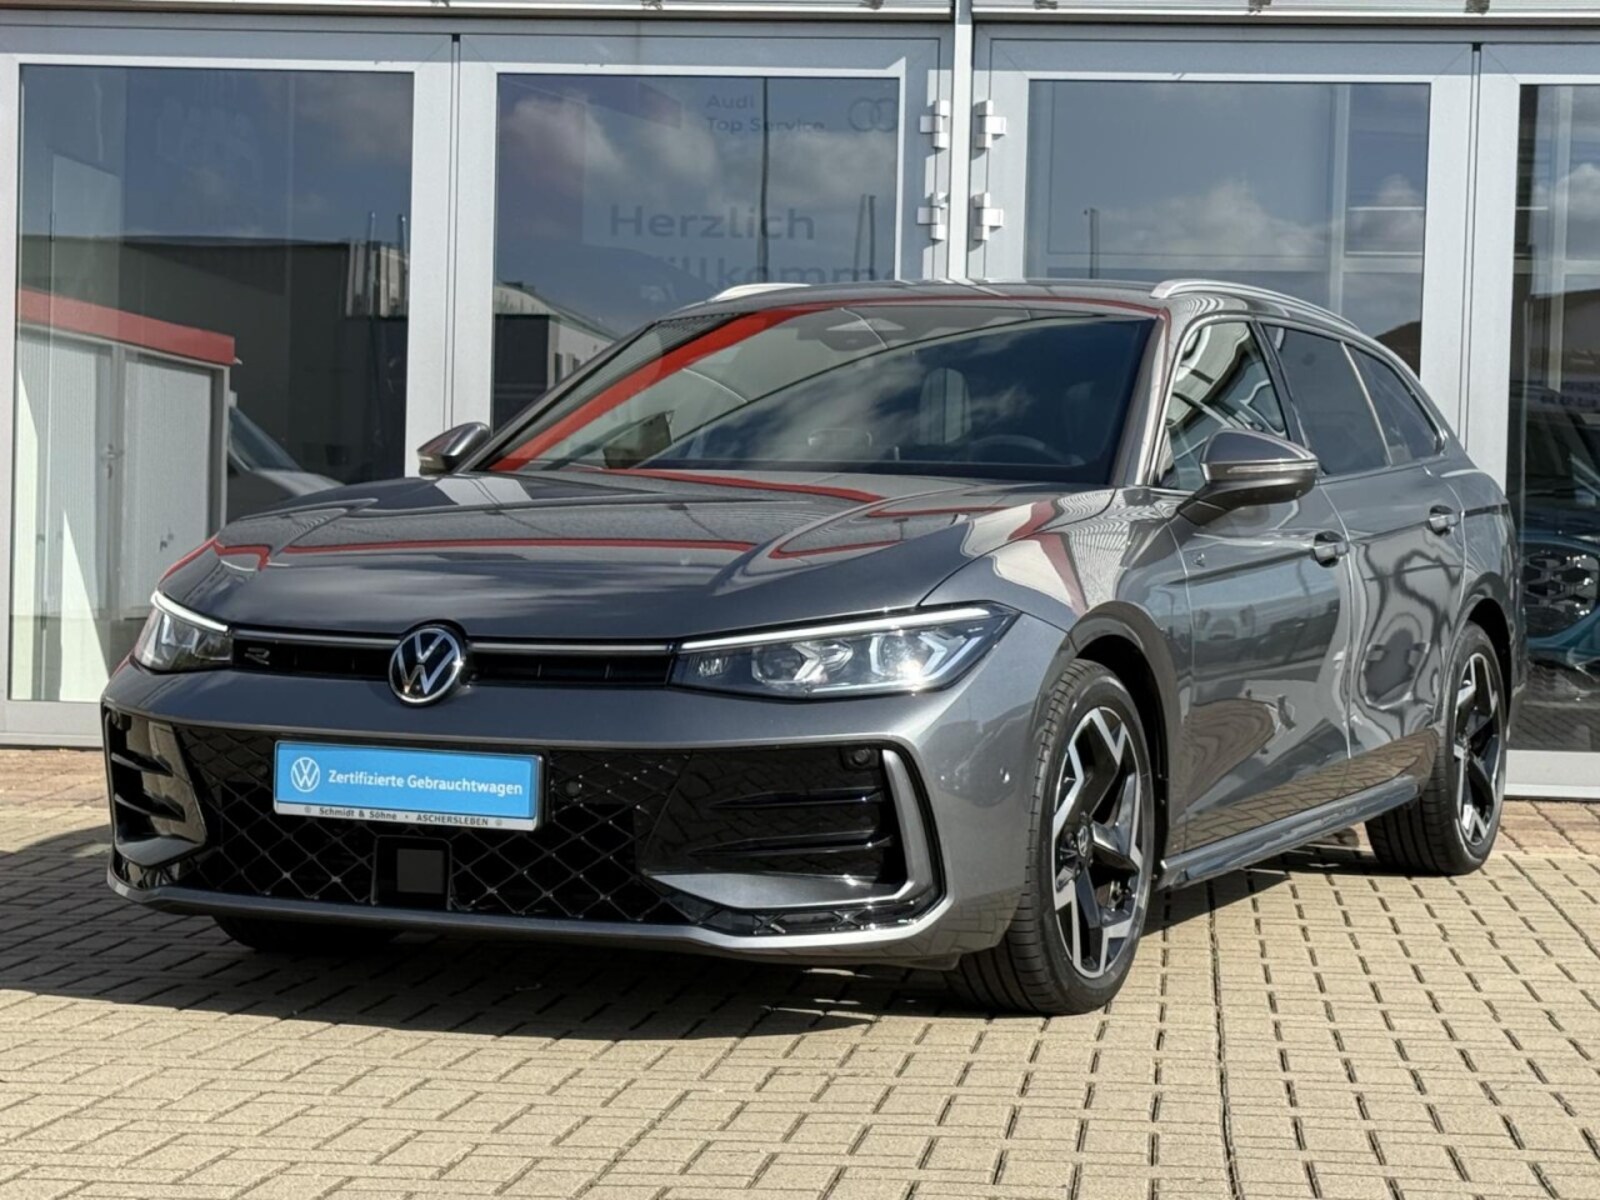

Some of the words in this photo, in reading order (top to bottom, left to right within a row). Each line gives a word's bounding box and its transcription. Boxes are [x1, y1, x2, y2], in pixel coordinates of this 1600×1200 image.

[706, 94, 755, 110] Audi
[706, 117, 743, 134] Top
[609, 204, 815, 240] Herzlich
[327, 769, 404, 788] Zertifizierte
[407, 774, 523, 797] Gebrauchtwagen
[319, 806, 355, 817] Schmidt
[358, 810, 365, 818] &
[369, 810, 397, 820] Söhne
[416, 813, 489, 826] ASCHERSLEBEN
